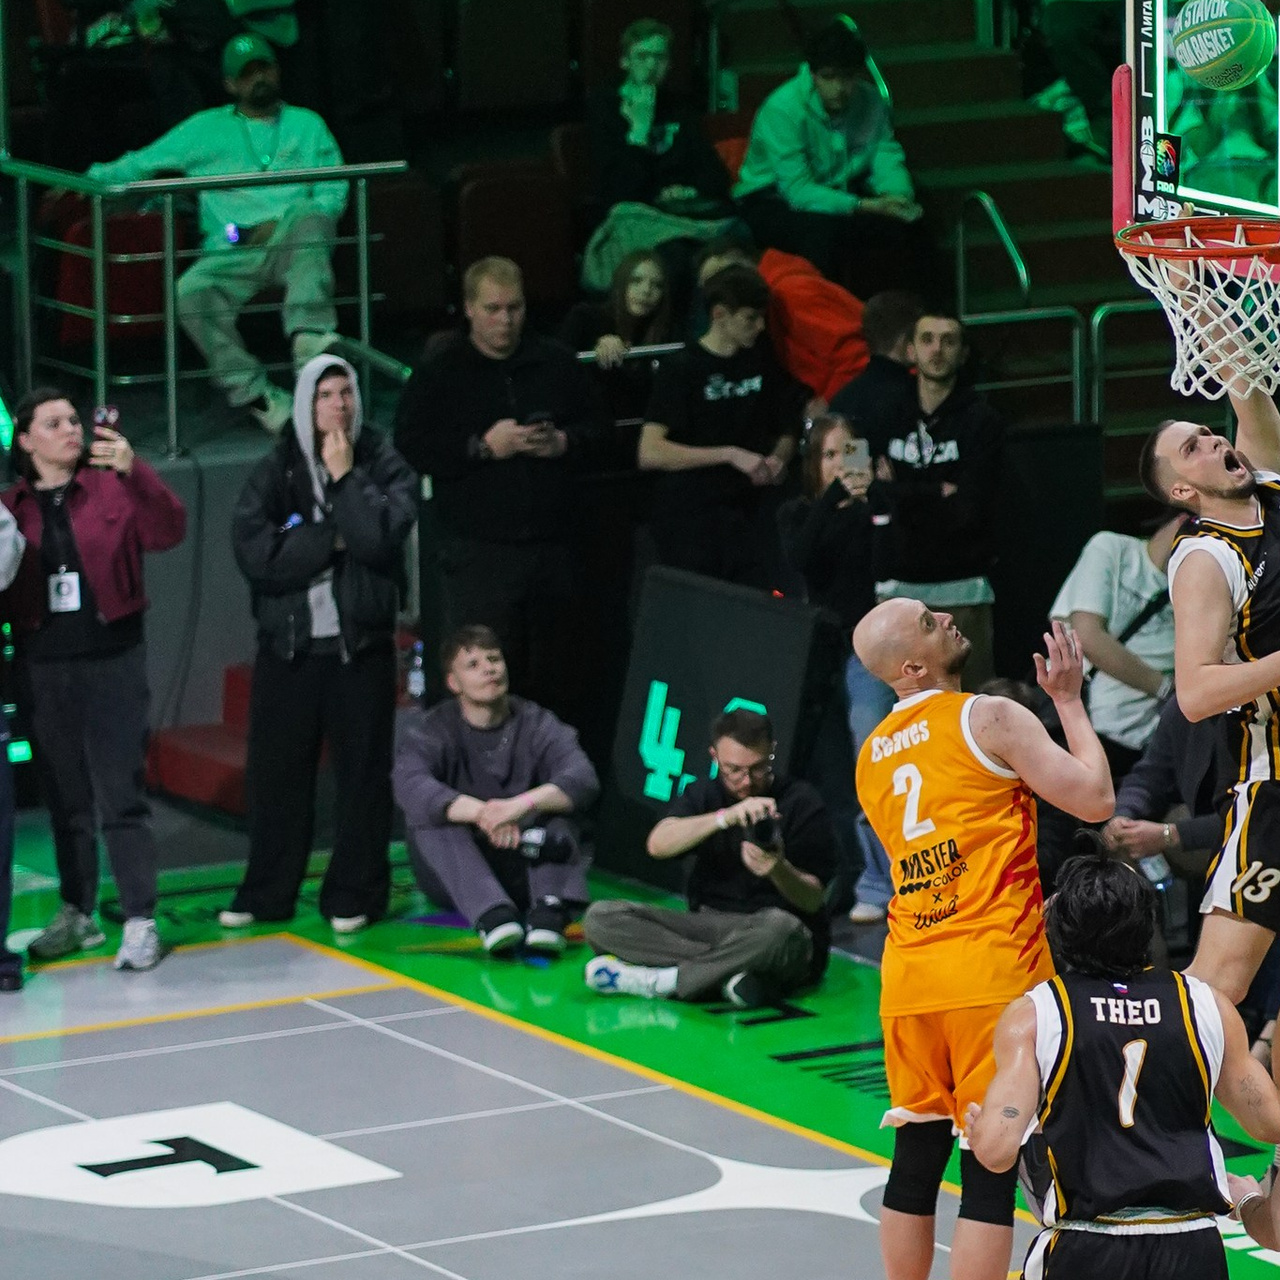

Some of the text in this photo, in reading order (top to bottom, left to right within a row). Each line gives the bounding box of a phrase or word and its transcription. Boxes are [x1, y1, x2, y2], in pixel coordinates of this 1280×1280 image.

[1190, 27, 1235, 64] BASKET
[892, 763, 936, 842] 2
[899, 838, 962, 883] MASTER
[933, 861, 969, 887] COLOR
[1090, 997, 1162, 1026] THEO
[1117, 1038, 1148, 1129] 1
